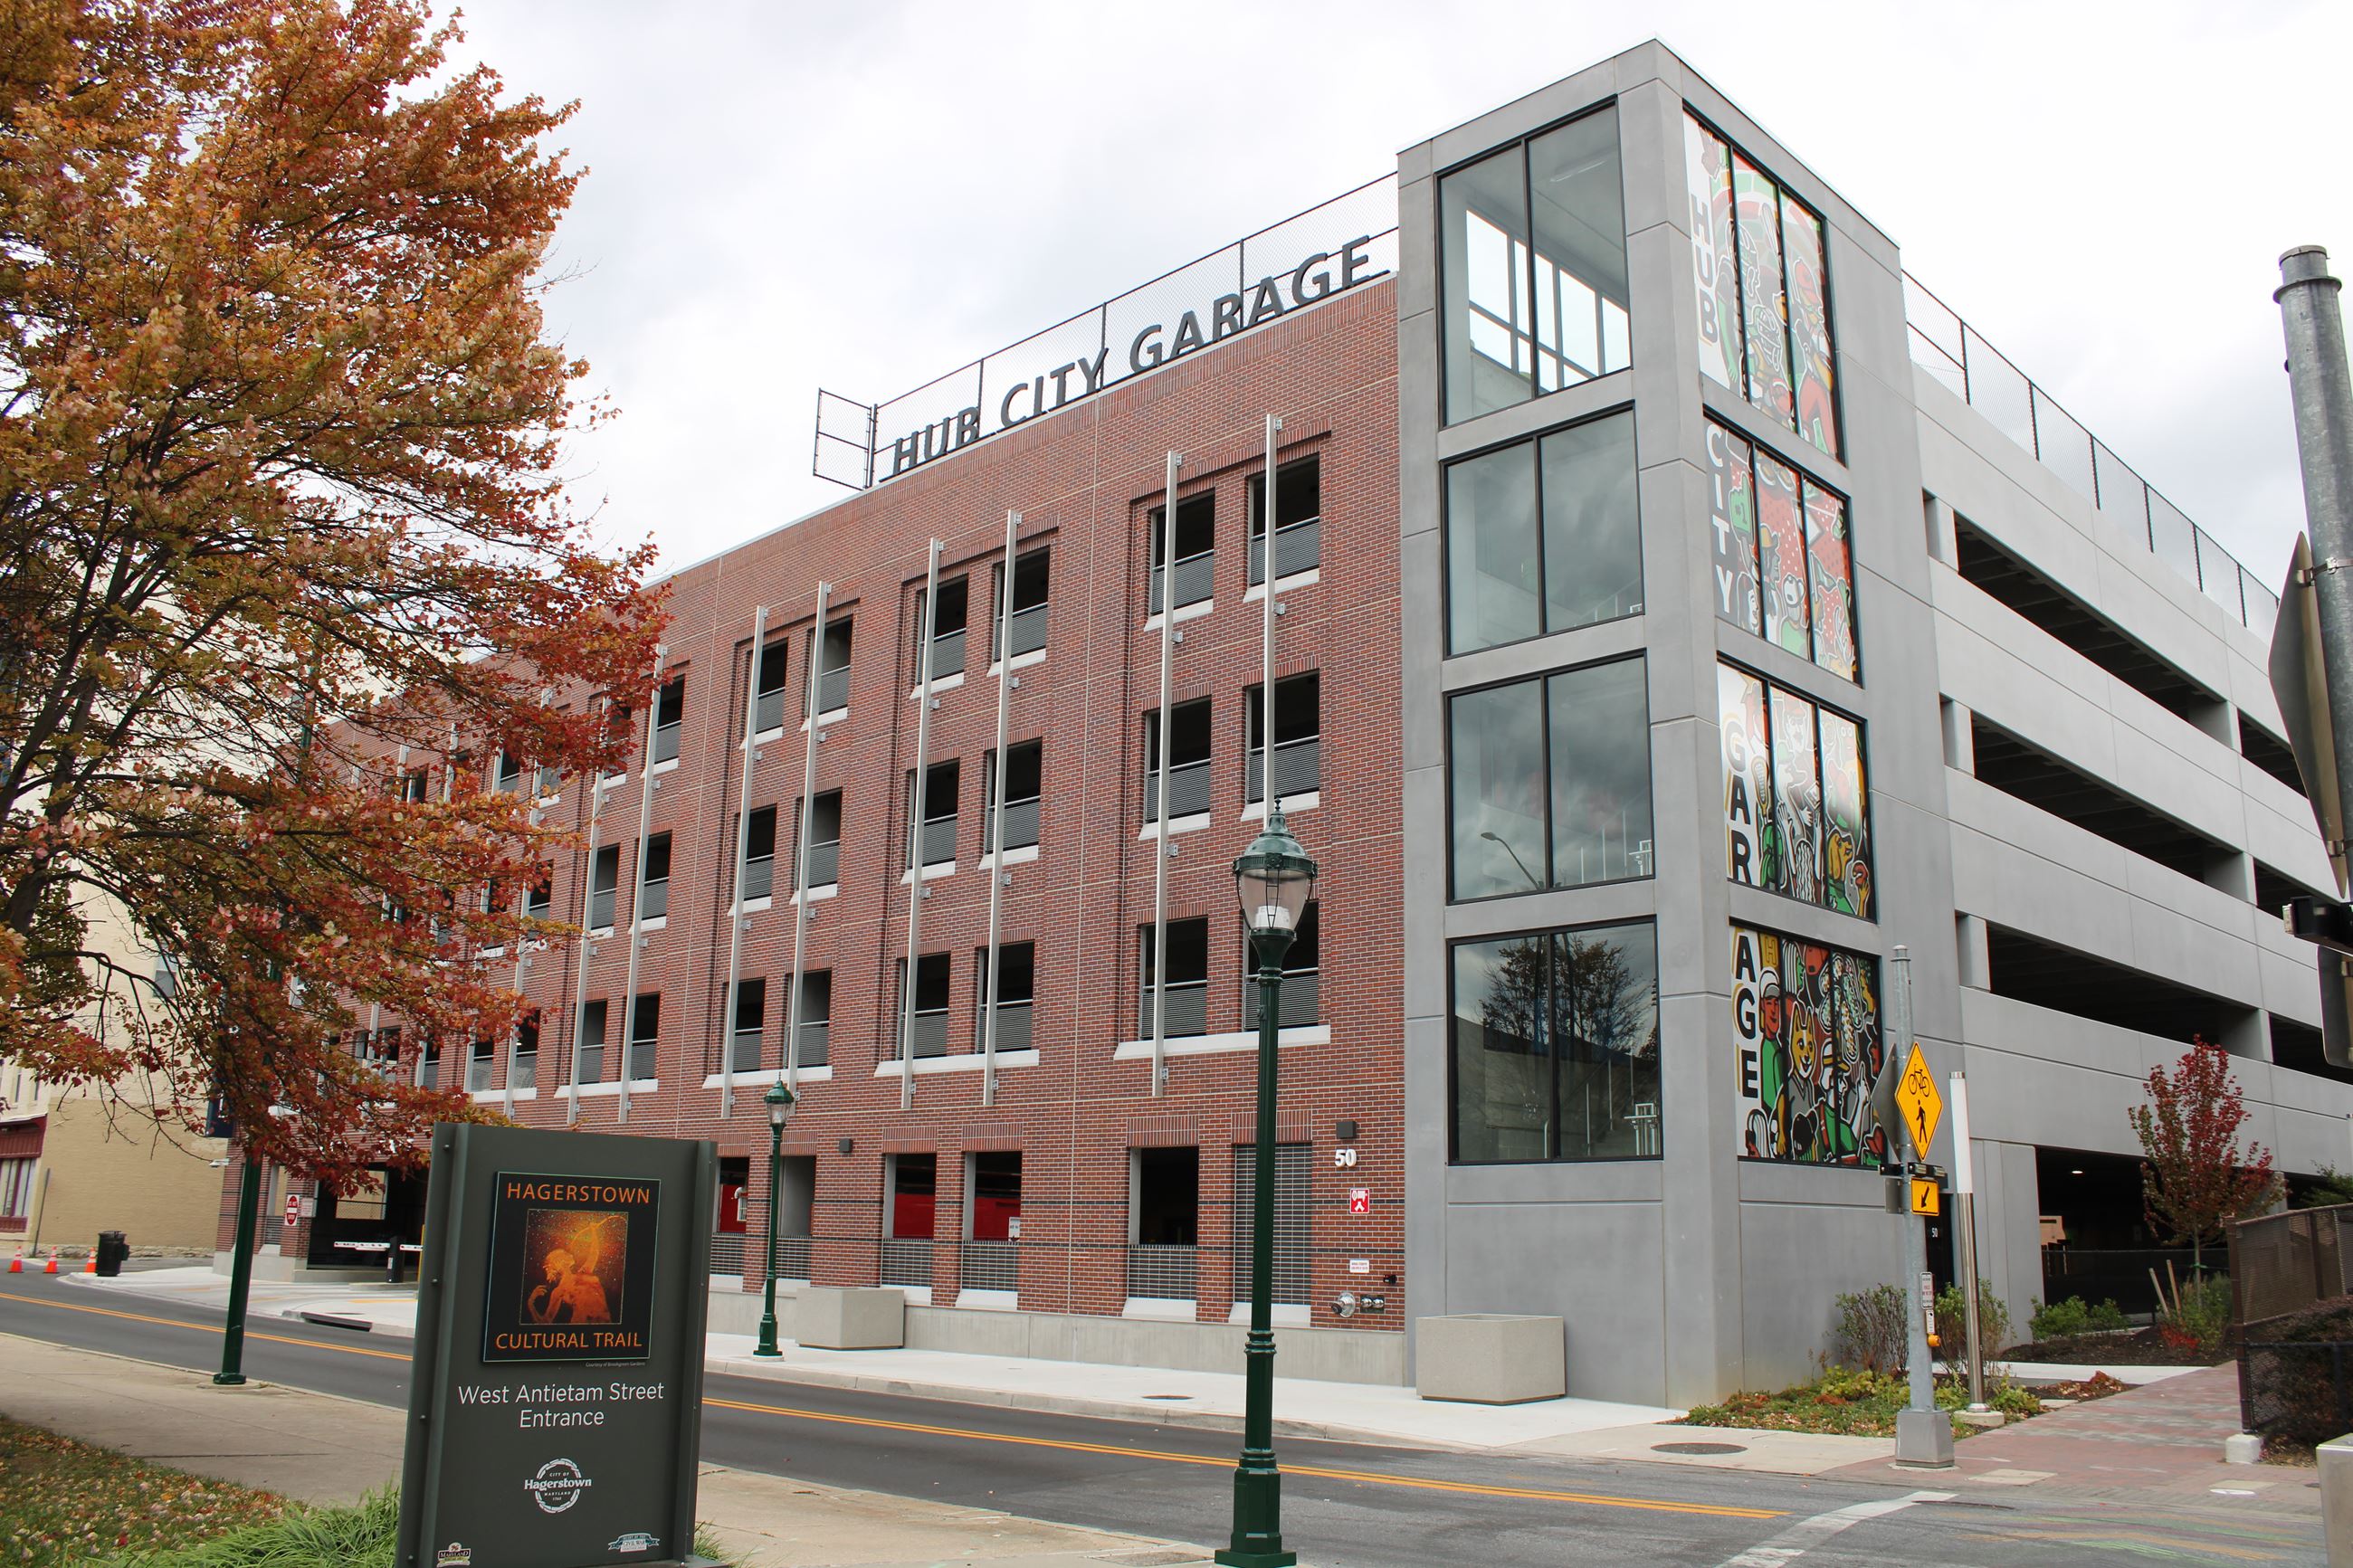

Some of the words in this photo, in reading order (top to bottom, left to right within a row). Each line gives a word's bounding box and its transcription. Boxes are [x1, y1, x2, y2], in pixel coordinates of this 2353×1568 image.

[892, 406, 980, 476] HUB
[1000, 347, 1110, 429] CITY
[1129, 235, 1371, 375] GARAGE
[1706, 424, 1734, 616] CITY
[1335, 1149, 1357, 1167] 50
[507, 1183, 650, 1204] HAGERSTOWN
[496, 1333, 589, 1349] CULTURAL
[594, 1332, 643, 1347] TRAIL
[458, 1385, 510, 1404] West
[516, 1383, 603, 1402] Antietam
[609, 1383, 664, 1401] Street
[519, 1410, 605, 1428] Entrance
[524, 1478, 592, 1491] Hagerstown
